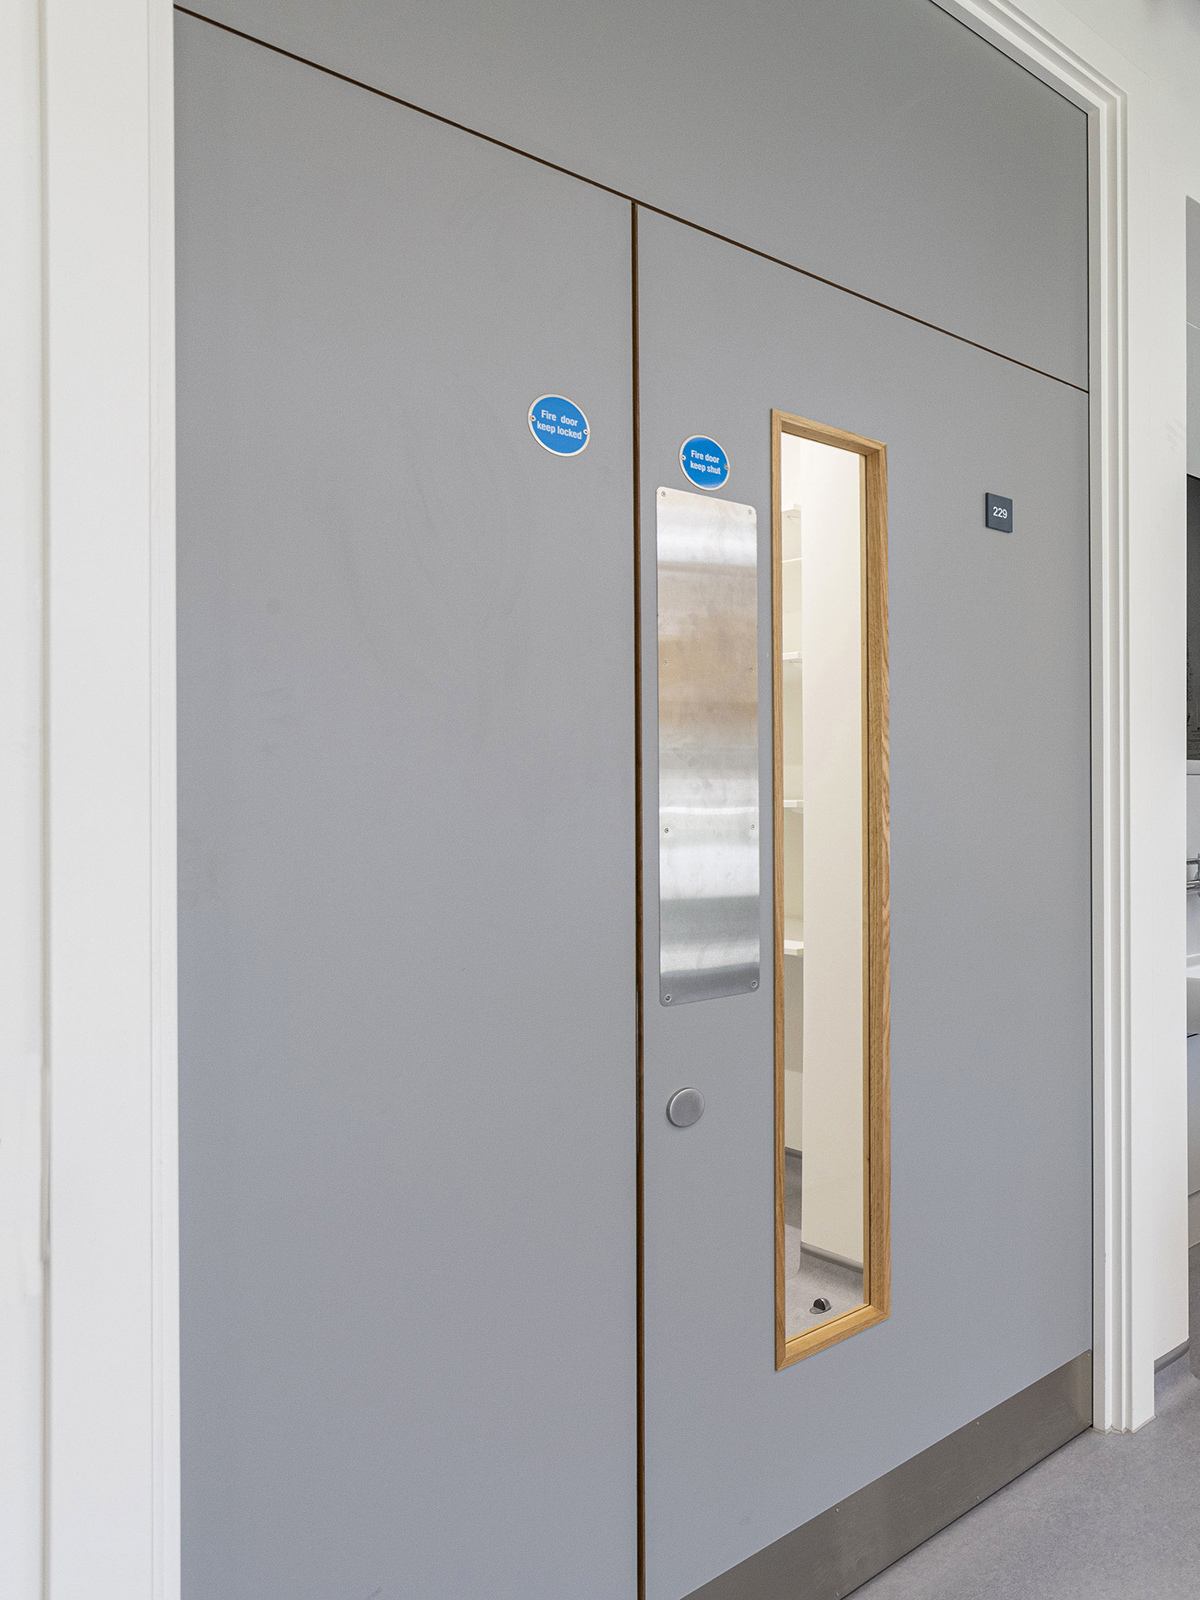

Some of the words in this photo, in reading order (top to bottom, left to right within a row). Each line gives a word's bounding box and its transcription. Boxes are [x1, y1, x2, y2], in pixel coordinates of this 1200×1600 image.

[541, 409, 557, 421] Fire
[560, 415, 579, 427] door
[536, 420, 556, 434] keep
[557, 426, 582, 440] locked
[690, 449, 704, 460] Fire
[705, 453, 720, 464] door
[690, 460, 706, 473] keep
[707, 465, 721, 475] shut
[992, 506, 1008, 519] 229
